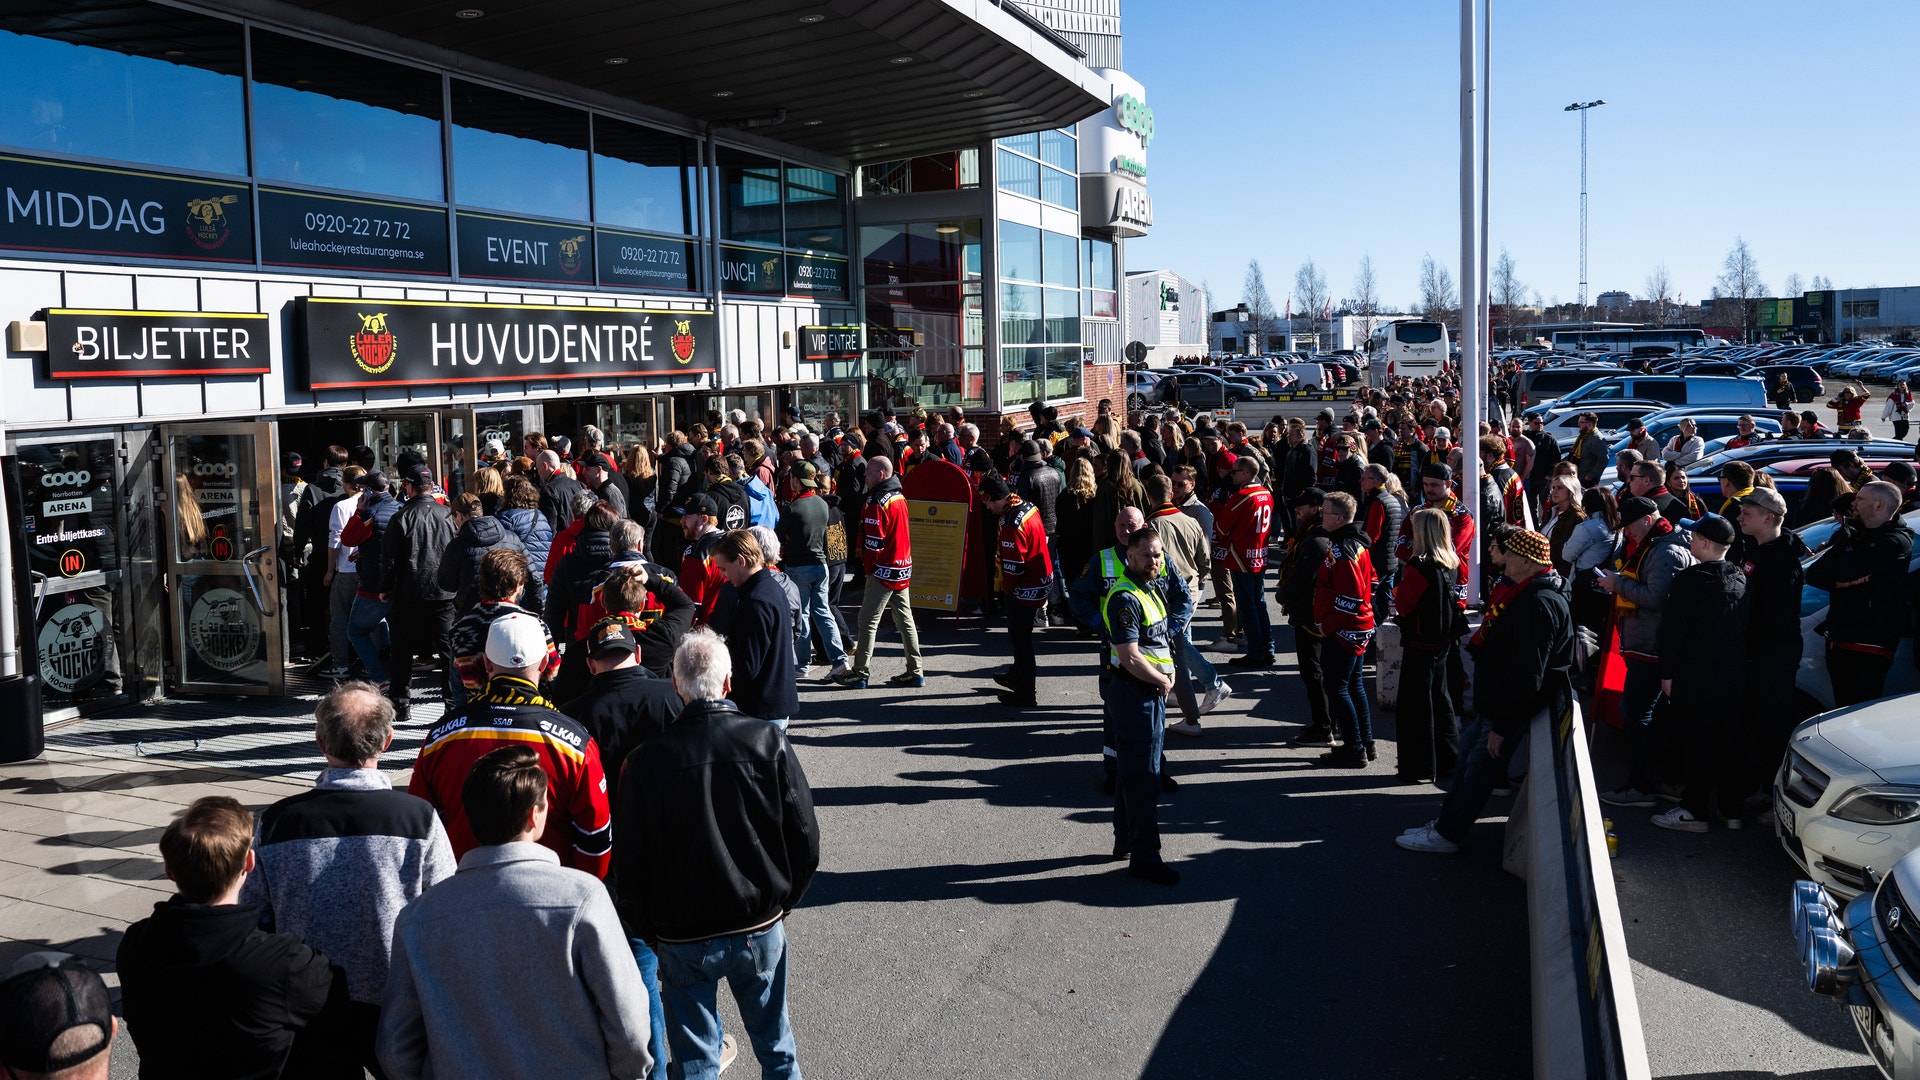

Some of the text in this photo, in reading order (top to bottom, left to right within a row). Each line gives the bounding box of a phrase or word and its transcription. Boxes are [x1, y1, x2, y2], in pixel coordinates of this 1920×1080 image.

[1119, 93, 1154, 148] coop
[7, 187, 165, 235] MIDDAG
[305, 212, 411, 240] 0920-22 72 72
[290, 237, 424, 260] luleahockeyrestaurangerna.se
[487, 237, 549, 266] EVENT
[621, 246, 680, 265] 0920-22 72 72
[798, 265, 837, 280] 0920-22 72 72
[77, 326, 251, 360] BILJETTER
[356, 331, 393, 344] LULEÅ
[432, 317, 655, 366] HUVUDENTRÉ
[811, 330, 857, 351] VIP ENTRÉ
[486, 430, 511, 443] coop
[41, 470, 91, 488] coop
[193, 462, 239, 479] coop
[52, 490, 83, 499] Norrbotten
[199, 492, 234, 500] ARENA
[49, 501, 87, 514] ARENA
[1254, 504, 1271, 534] 19
[36, 528, 106, 545] Entré biljettkassa
[215, 542, 229, 557] IN
[64, 554, 80, 572] IN
[440, 716, 468, 735] LKAB
[492, 717, 513, 726] SSAB
[550, 723, 582, 747] LKAB
